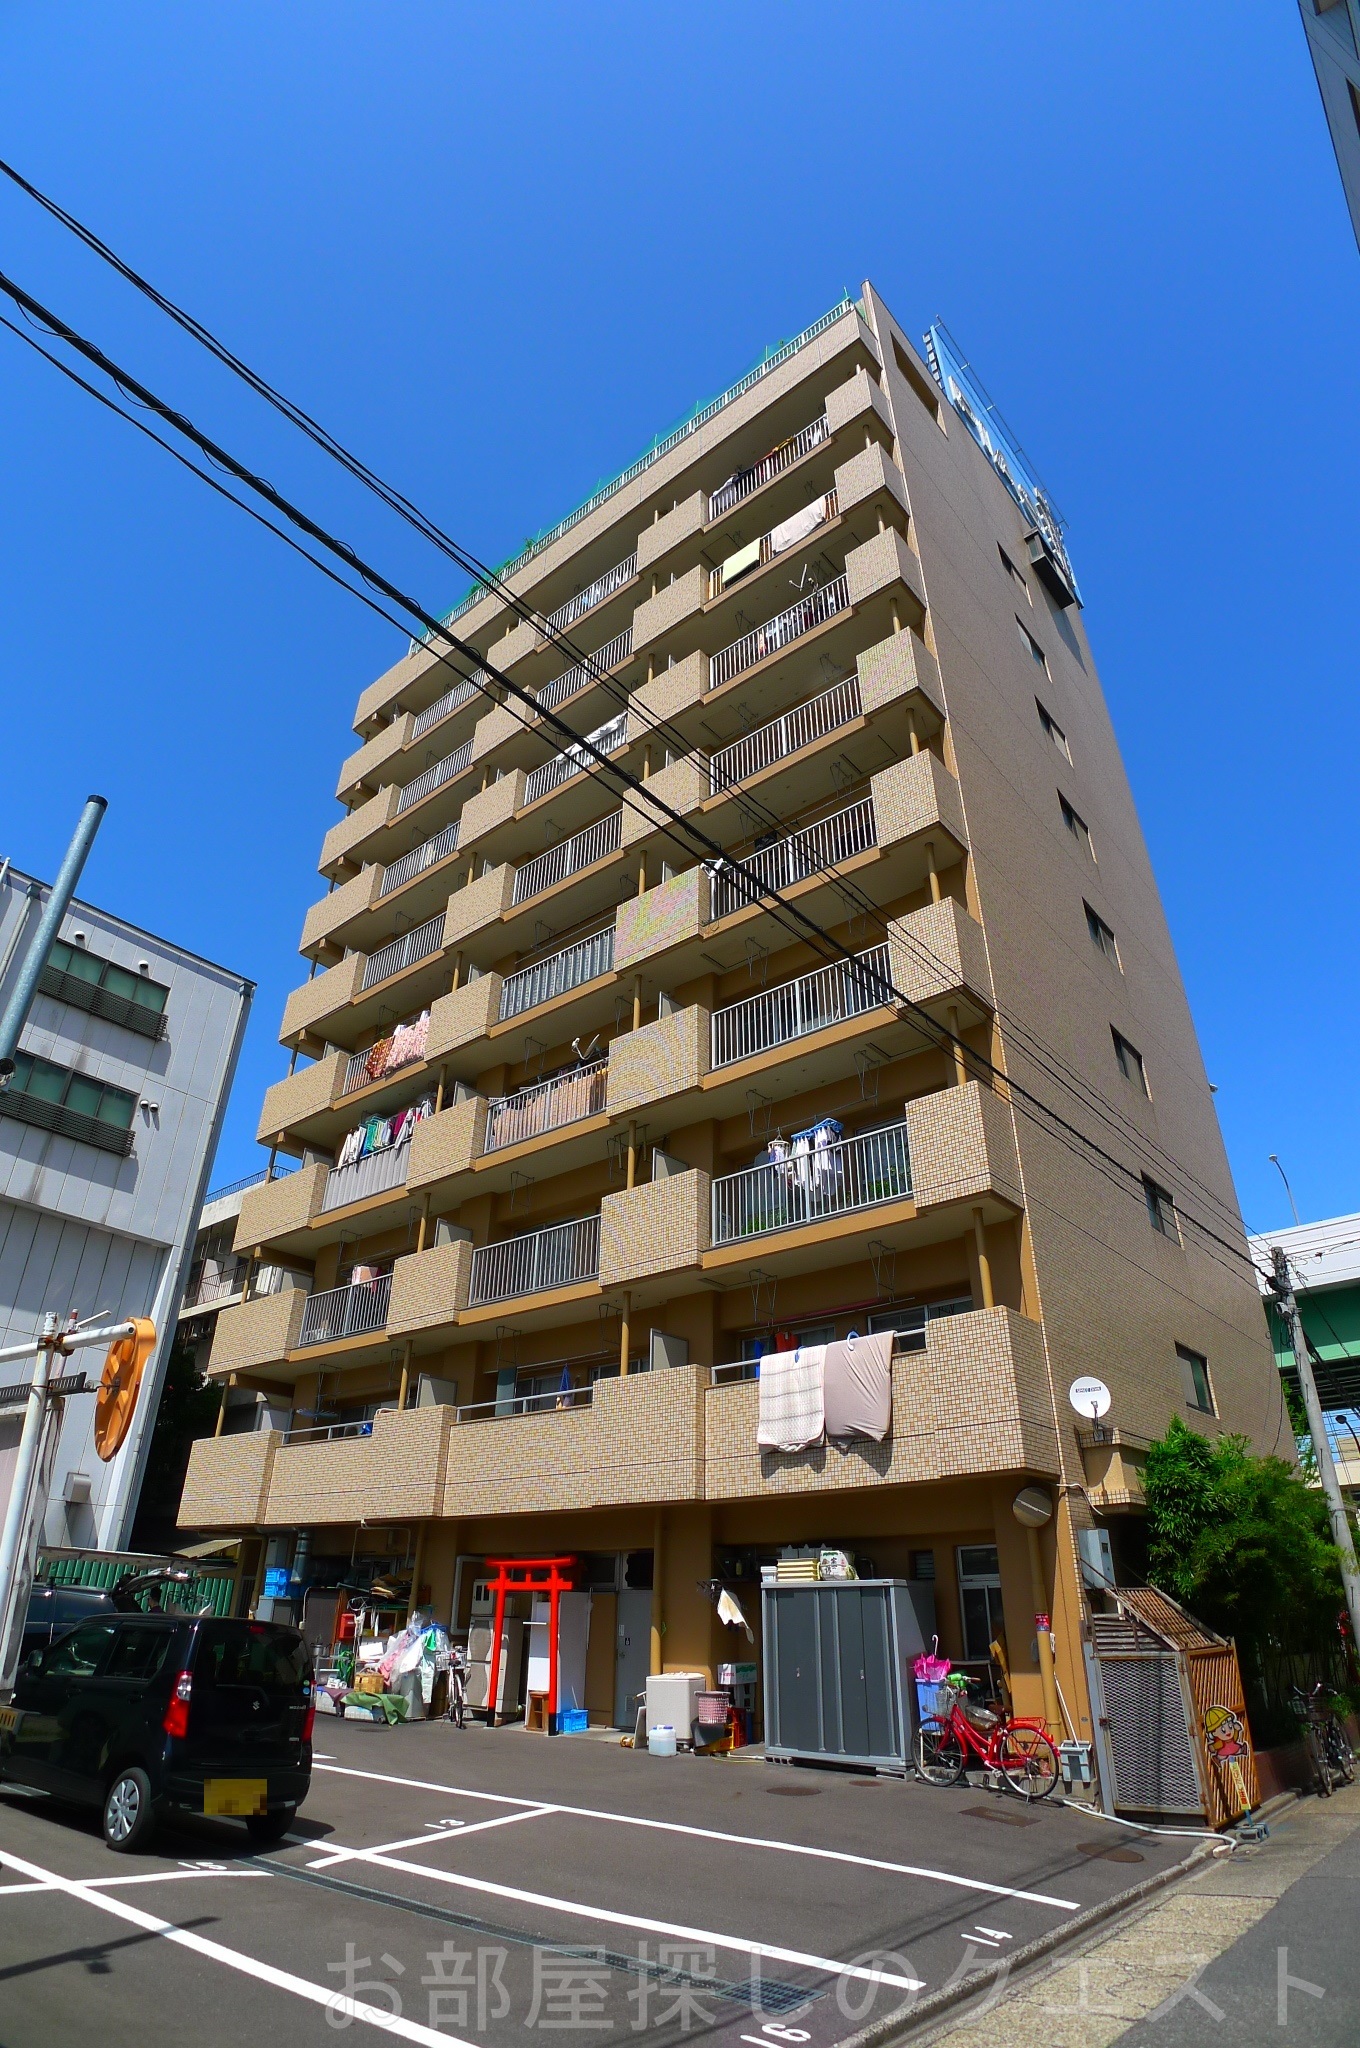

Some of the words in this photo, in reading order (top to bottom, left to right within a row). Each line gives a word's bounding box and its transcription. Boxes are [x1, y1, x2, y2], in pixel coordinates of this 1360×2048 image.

[424, 1819, 466, 1830] 13
[177, 1861, 228, 1870] 15
[960, 1926, 1013, 1947] 14
[740, 2023, 812, 2048] 16
